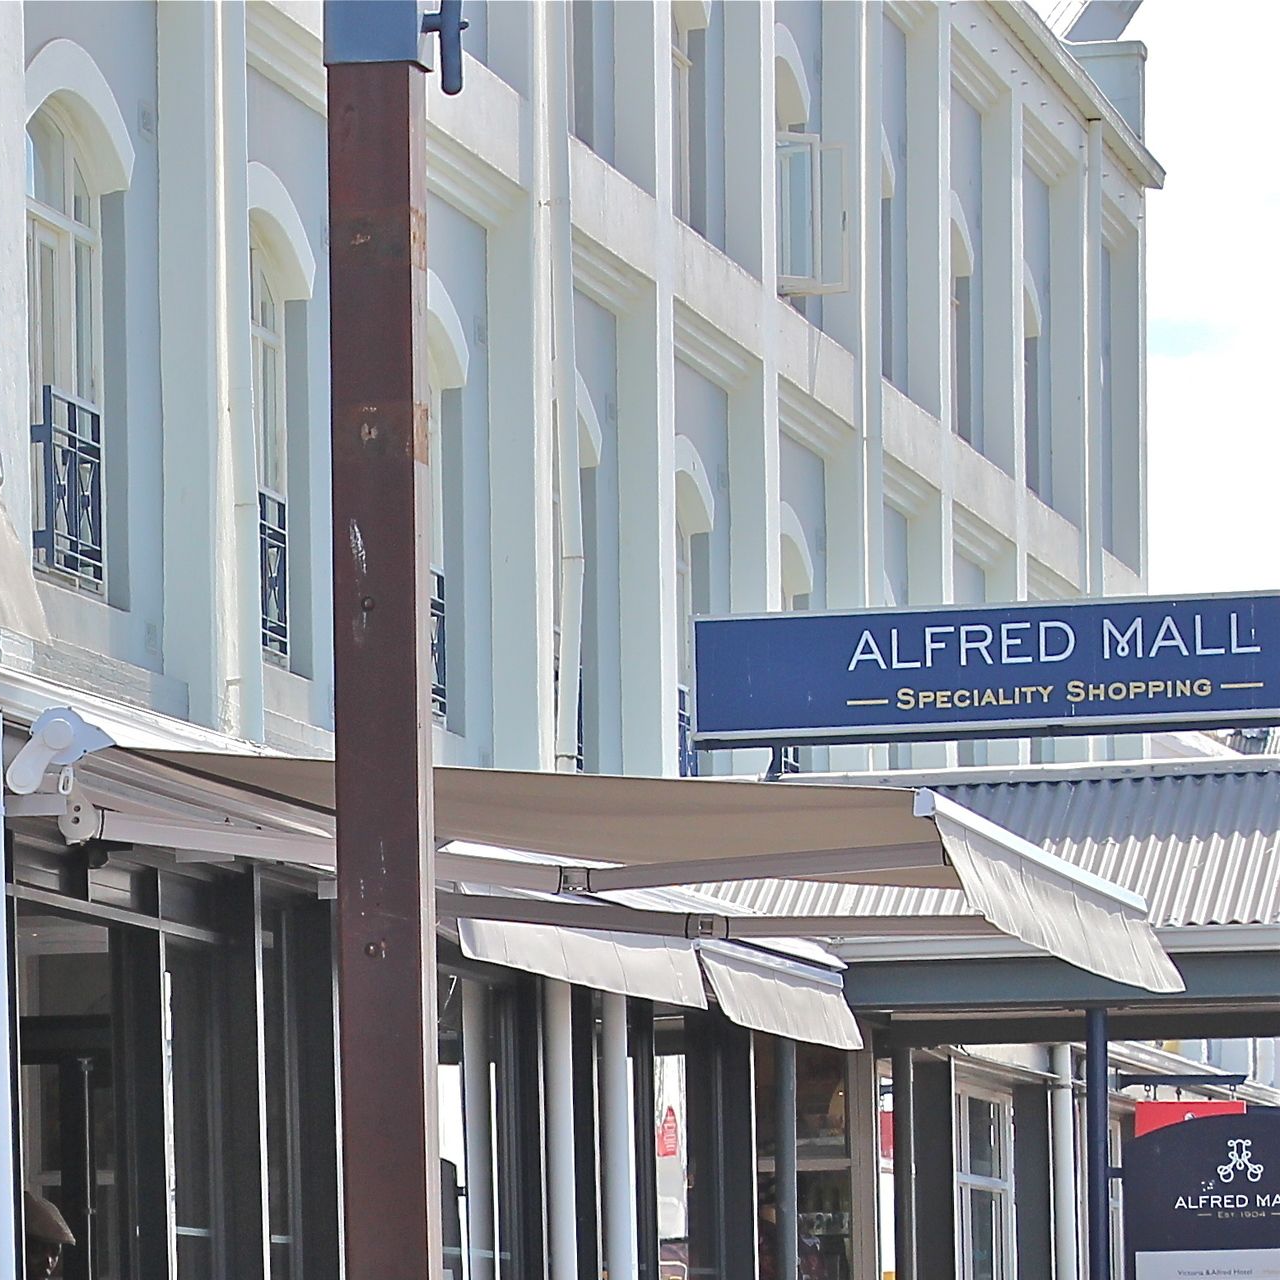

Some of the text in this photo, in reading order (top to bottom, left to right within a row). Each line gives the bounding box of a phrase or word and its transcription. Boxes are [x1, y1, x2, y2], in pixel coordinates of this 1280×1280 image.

[847, 612, 1261, 671] ALFRED MALL
[1174, 1194, 1249, 1209] ALFRED
[1240, 1210, 1266, 1218] 1904
